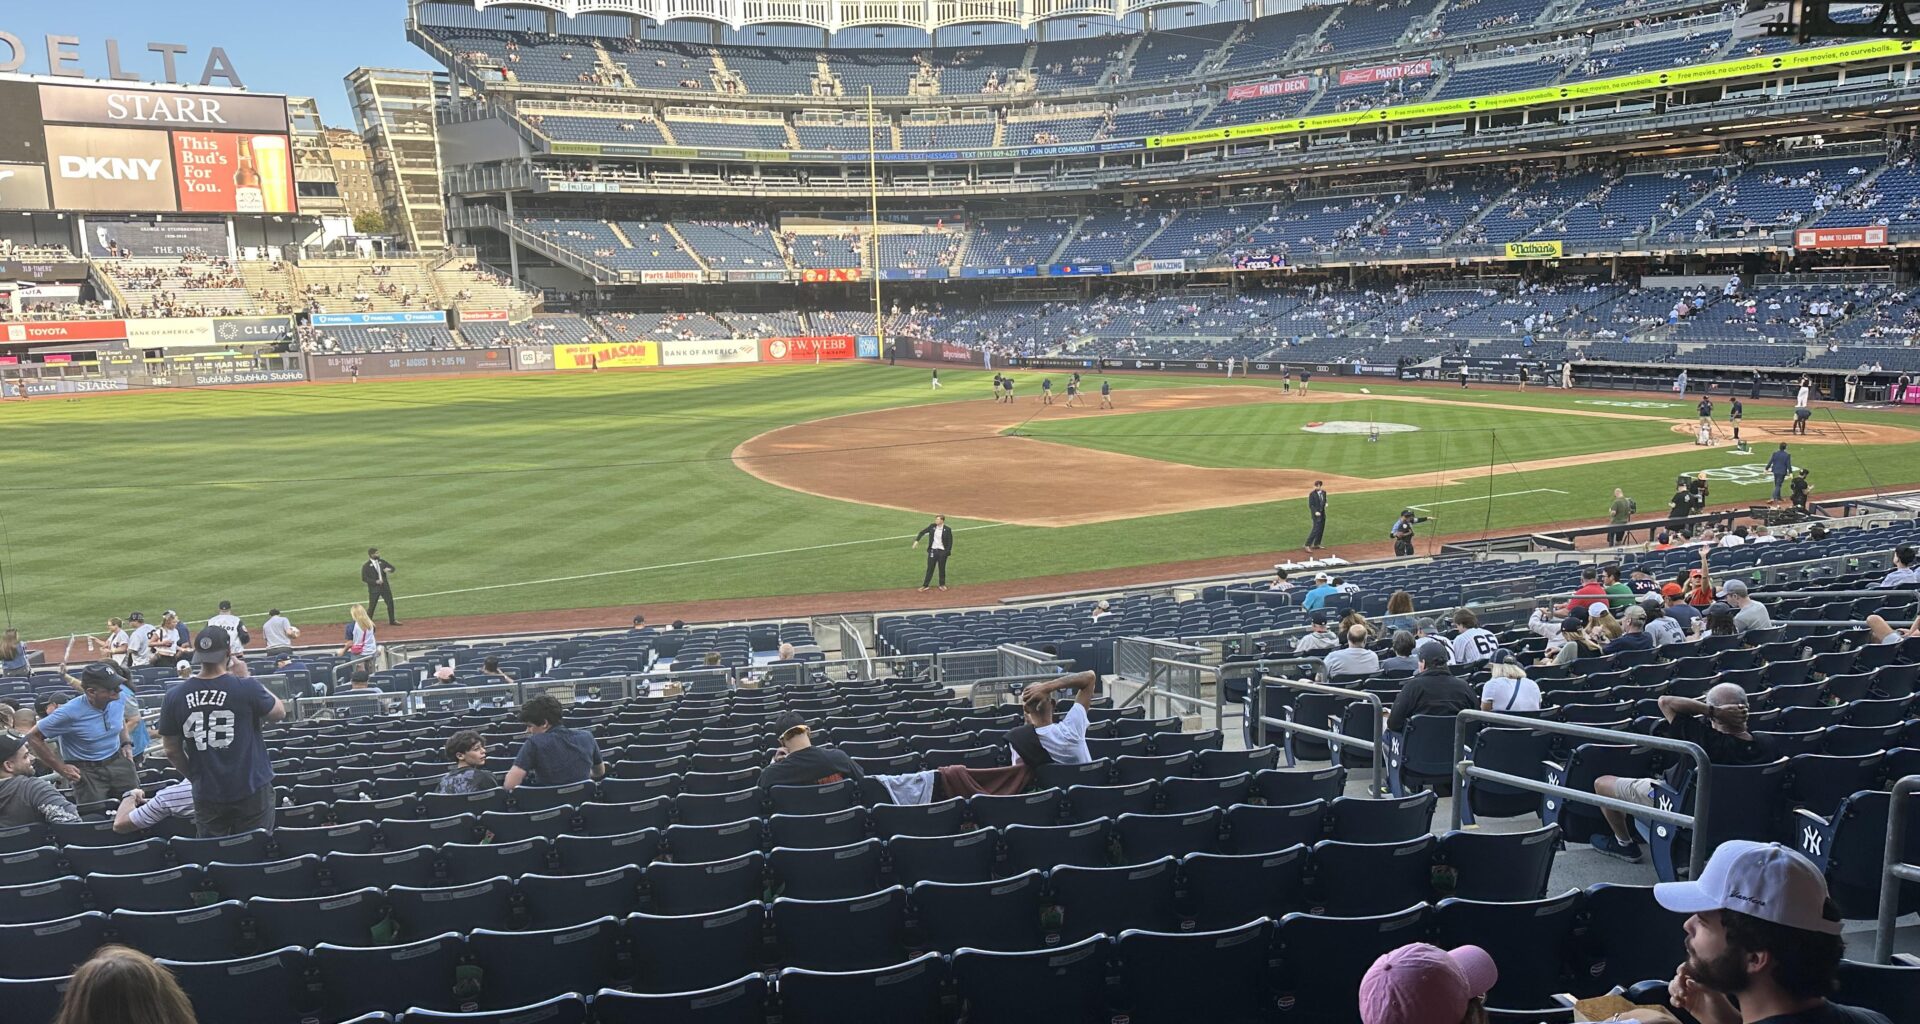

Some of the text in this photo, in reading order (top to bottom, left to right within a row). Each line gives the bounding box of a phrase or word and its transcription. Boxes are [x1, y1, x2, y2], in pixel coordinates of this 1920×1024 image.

[0, 30, 244, 88] DELTA
[1793, 56, 1808, 64] Free
[1375, 65, 1403, 79] PARTY
[1404, 62, 1428, 75] DECK
[1678, 72, 1691, 80] Free
[1260, 82, 1284, 95] PARTY
[1285, 79, 1306, 92] DECK
[107, 93, 227, 124] STARR
[179, 136, 218, 150] This
[181, 150, 228, 165] Bud's
[926, 152, 958, 160] MESSAGES
[977, 151, 992, 159] (917)
[1029, 148, 1043, 156] JOIN
[1044, 147, 1057, 155] OUR
[1057, 145, 1096, 154] COMMUNITY!
[58, 155, 163, 181] DKNY
[183, 165, 212, 179] For
[185, 179, 222, 193] You.
[1842, 233, 1862, 241] LISTEN
[153, 246, 201, 254] THE BOSS
[1153, 261, 1182, 271] AMAZING
[665, 271, 698, 280] Authority
[29, 327, 68, 336] TOYOTA
[244, 325, 286, 334] CLEAR
[812, 338, 847, 349] WEBB
[597, 345, 646, 363] MASON
[701, 348, 738, 356] AMERICA
[389, 359, 401, 368] SAT
[406, 358, 428, 367] AUGUST
[455, 356, 466, 365] PM
[152, 377, 166, 385] 385
[197, 372, 304, 384] StubHub StubHub StubHub
[77, 380, 119, 391] STARR
[1473, 633, 1499, 655] 65
[185, 689, 227, 709] RIZZO
[182, 709, 235, 751] 48
[1391, 736, 1400, 756] NY
[1803, 825, 1823, 856] NY
